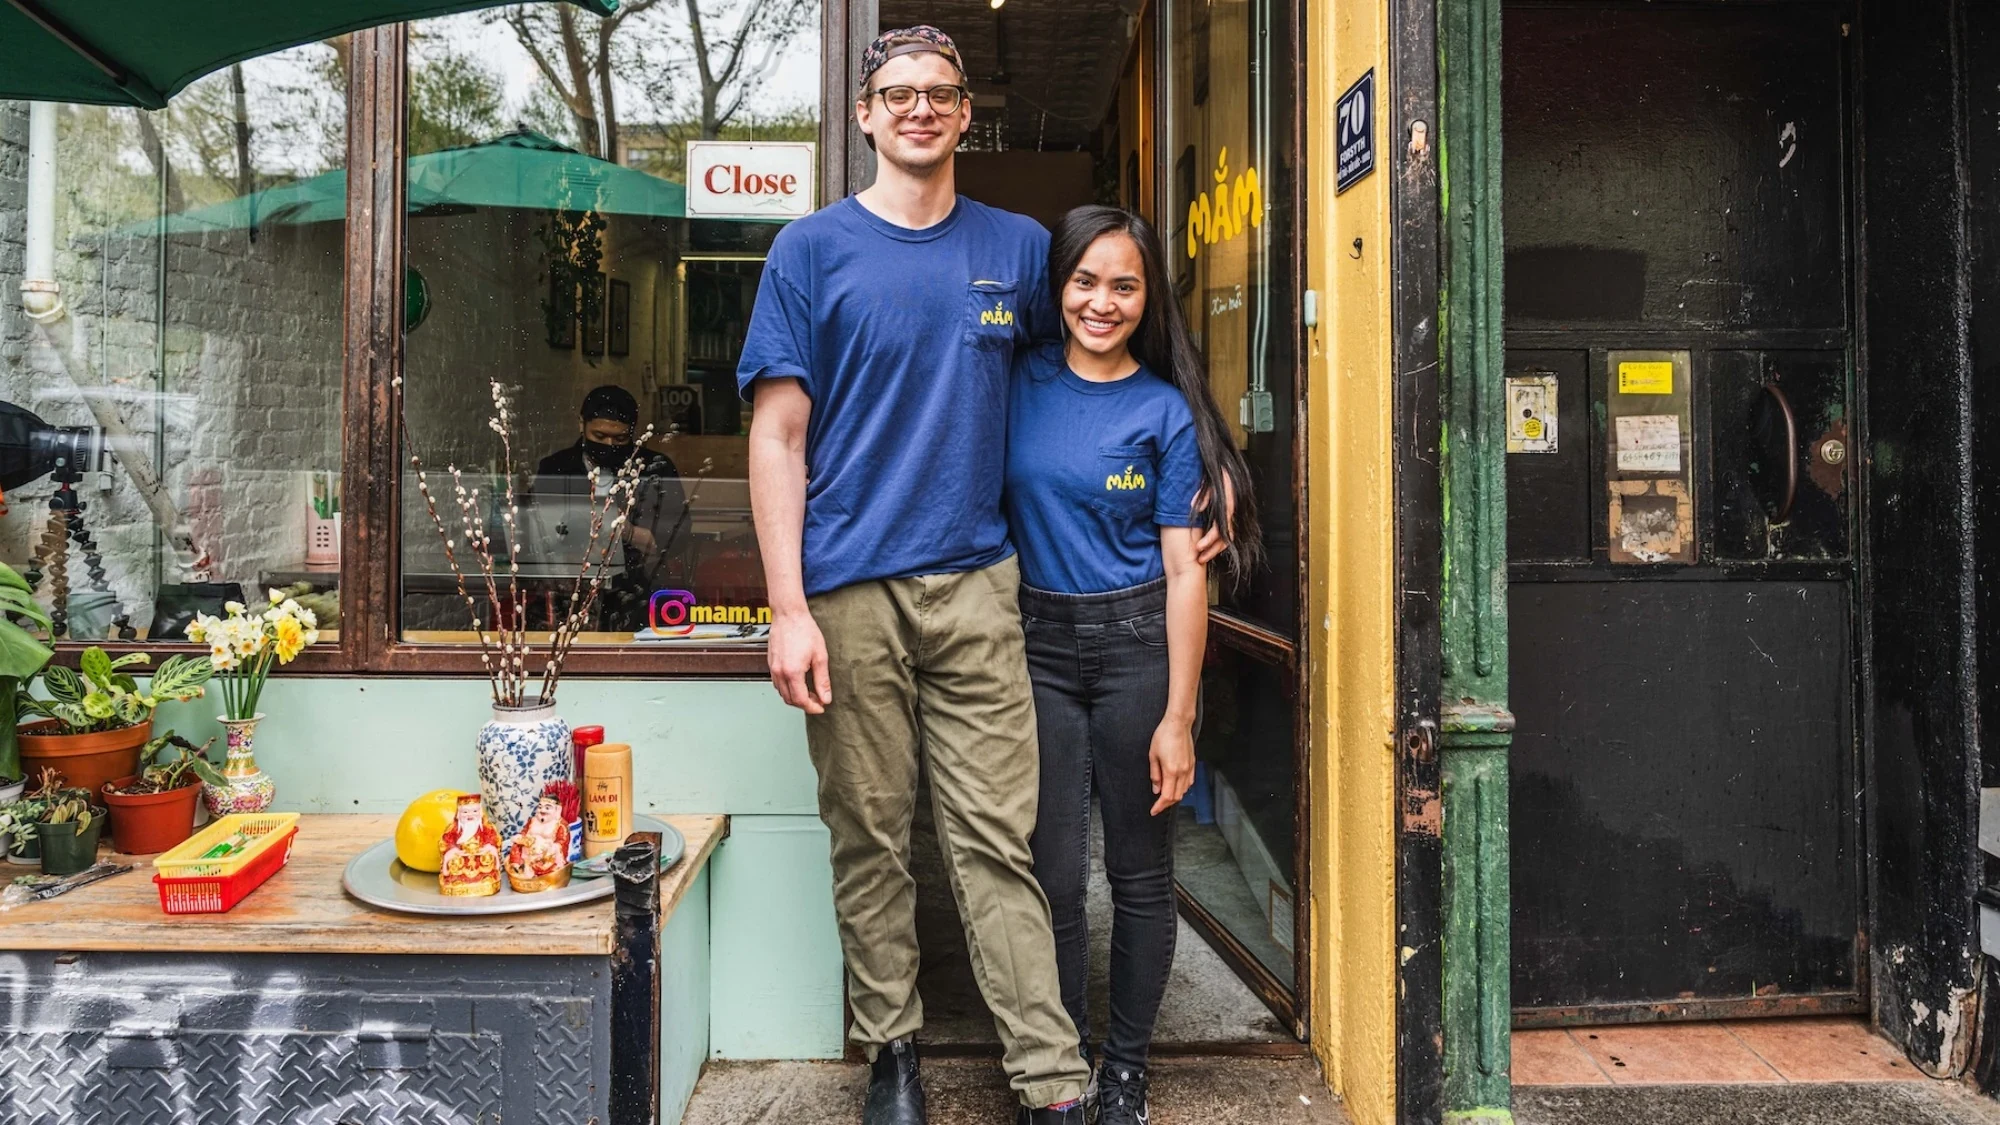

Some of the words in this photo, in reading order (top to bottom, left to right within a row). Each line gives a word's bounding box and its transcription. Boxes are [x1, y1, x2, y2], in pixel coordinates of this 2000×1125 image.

[1339, 90, 1366, 147] 70
[1339, 135, 1366, 166] FORSYTH
[704, 164, 797, 195] Close
[1187, 145, 1262, 259] MẮM
[661, 390, 693, 406] 100
